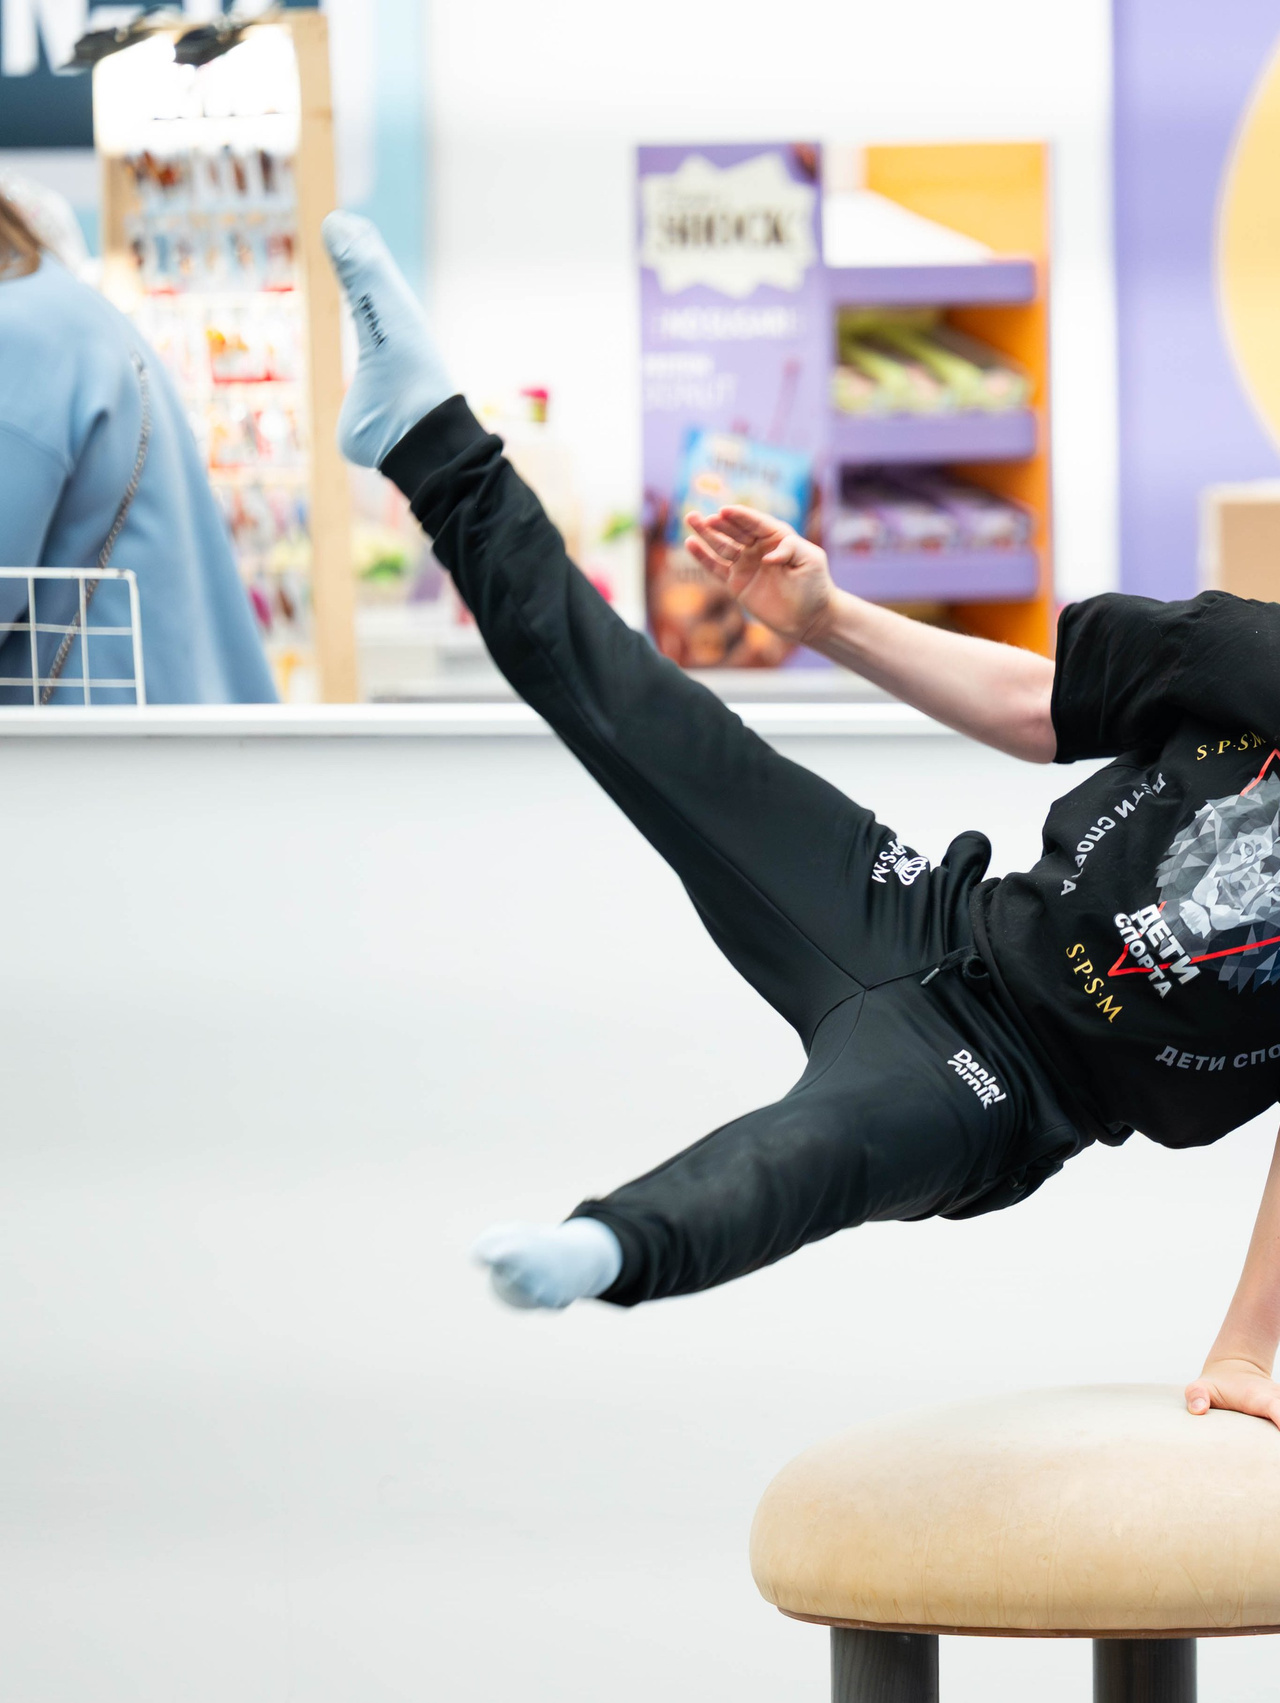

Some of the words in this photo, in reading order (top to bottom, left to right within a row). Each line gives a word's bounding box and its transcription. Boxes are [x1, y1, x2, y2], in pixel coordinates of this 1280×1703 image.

[1113, 912, 1172, 999] СПОРТА
[1130, 903, 1201, 985] ДЕТИ
[953, 1049, 1007, 1103] Daniel
[1155, 1045, 1226, 1071] ДЕТИ
